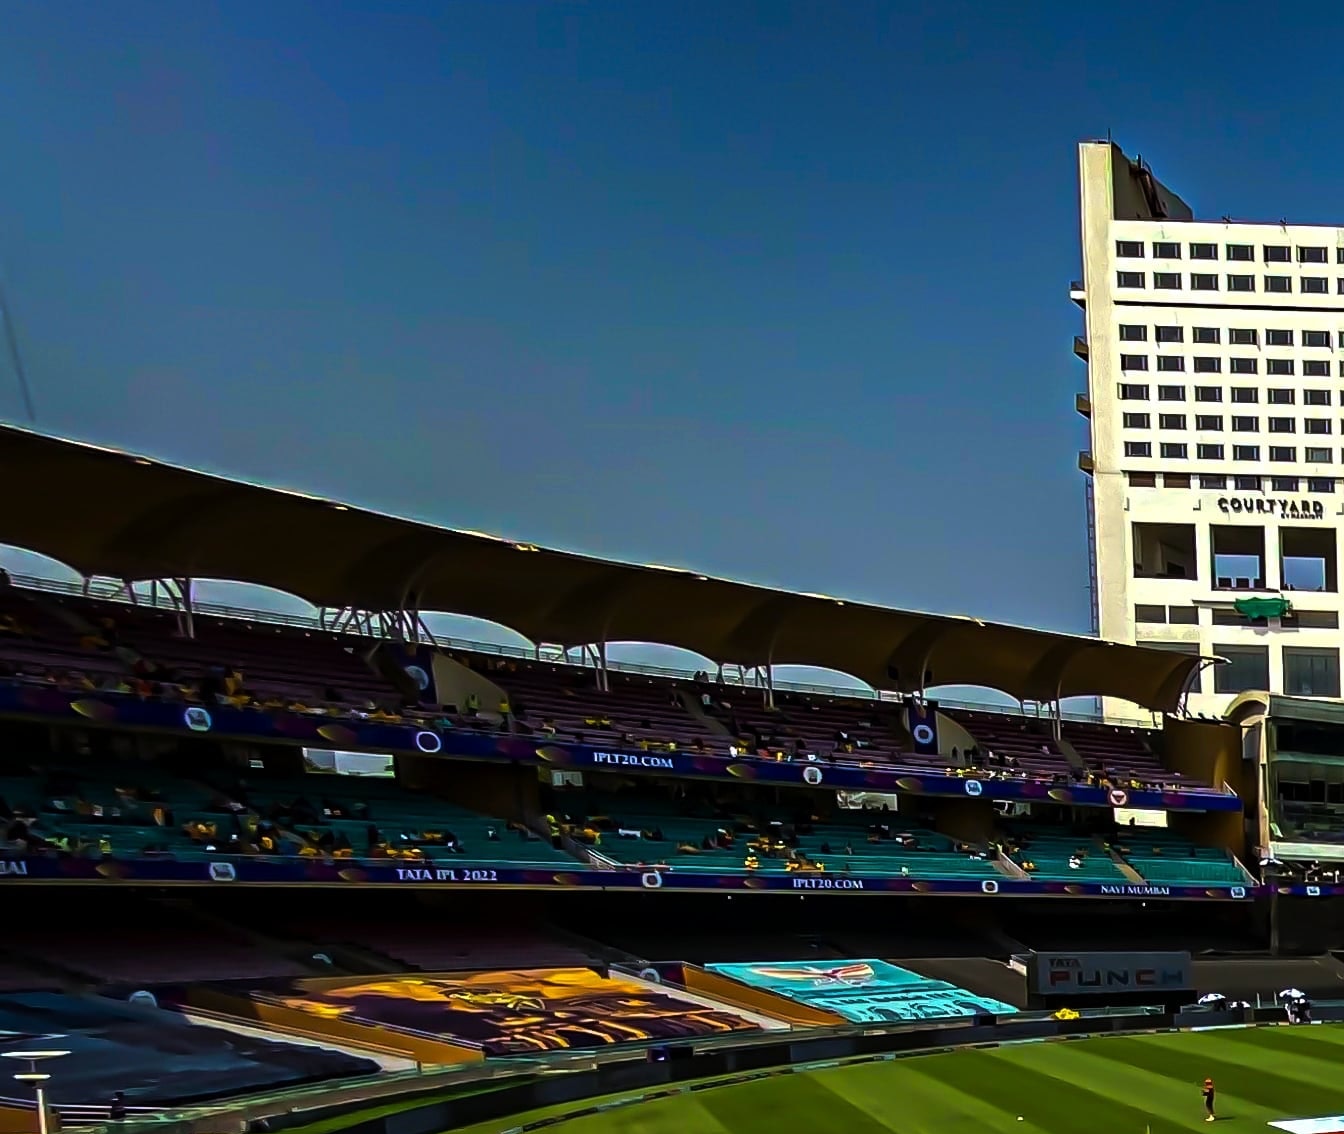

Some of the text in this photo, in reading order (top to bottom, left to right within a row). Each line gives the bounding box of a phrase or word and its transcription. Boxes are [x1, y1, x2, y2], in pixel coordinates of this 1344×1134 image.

[1218, 497, 1324, 514] COURTYARD
[593, 752, 674, 769] IPLT20.COM
[396, 869, 498, 881] TATA IPL 2022
[793, 878, 864, 889] IPLT20.COM
[1128, 886, 1170, 895] MUMBAI
[1050, 969, 1184, 987] PUNCH
